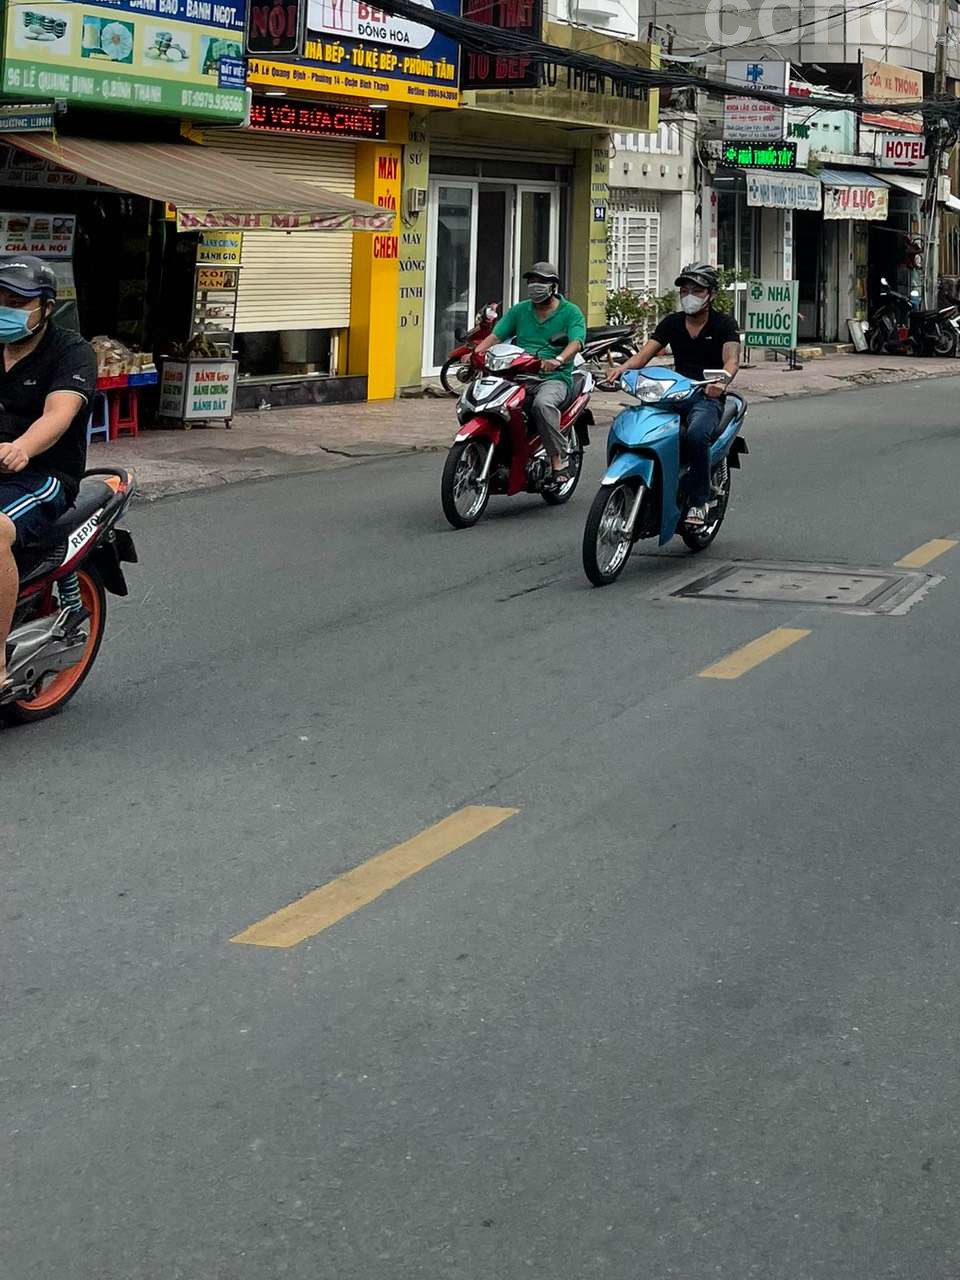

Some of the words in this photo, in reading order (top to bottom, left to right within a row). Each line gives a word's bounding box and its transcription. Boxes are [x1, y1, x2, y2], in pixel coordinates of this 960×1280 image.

[390, 29, 410, 43] HOA
[325, 41, 345, 64] BẾP
[380, 49, 397, 71] BẾP
[404, 55, 433, 77] PHÒNG
[885, 141, 925, 159] HOTEL
[378, 153, 398, 180] MÁY
[768, 282, 791, 301] NHÀ
[748, 306, 791, 331] THUỐC
[748, 335, 763, 345] GIA
[766, 334, 790, 346] PHÚC
